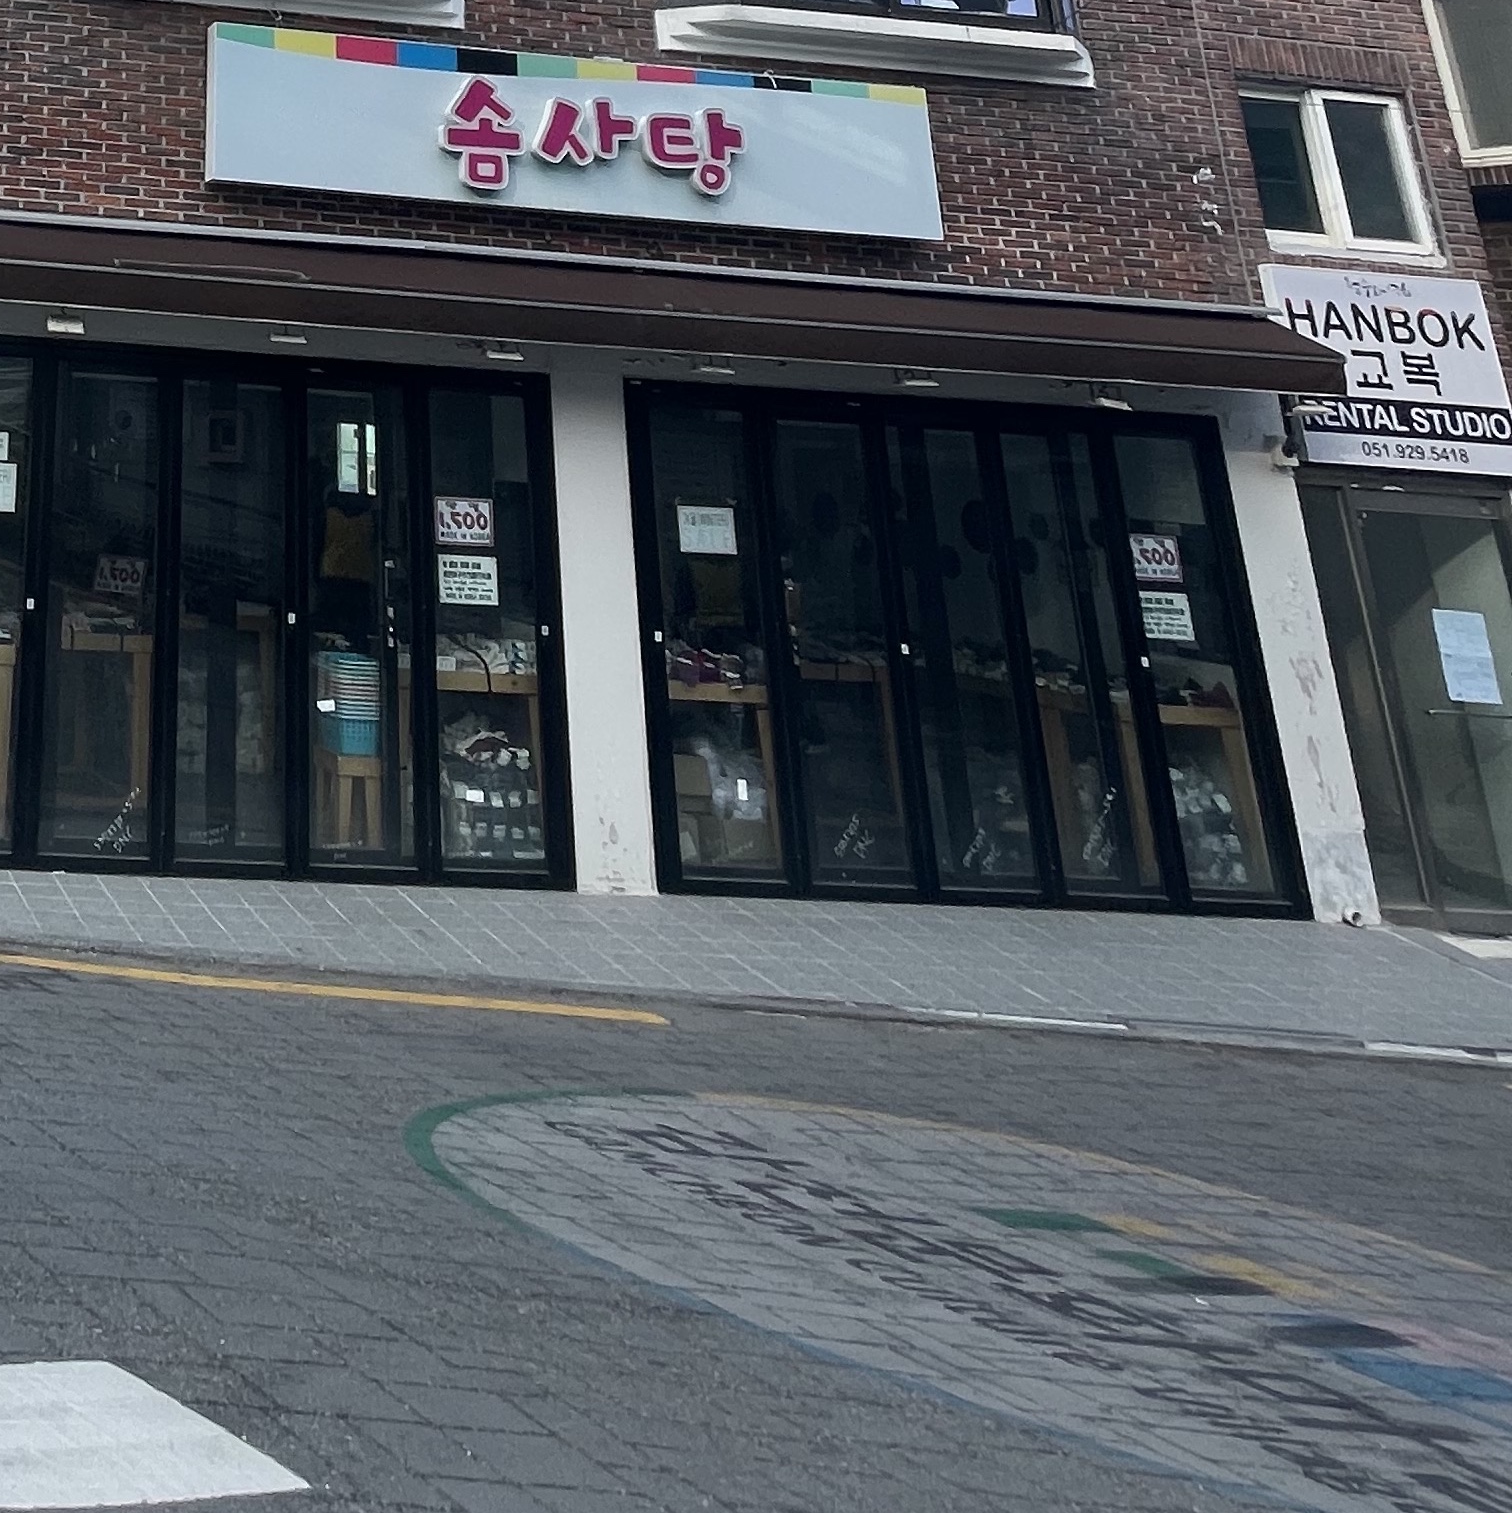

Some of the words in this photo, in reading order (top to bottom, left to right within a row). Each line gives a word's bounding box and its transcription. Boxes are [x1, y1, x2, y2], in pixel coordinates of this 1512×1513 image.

[441, 76, 744, 194] 솜사탕
[1284, 297, 1486, 352] HANBOK
[1349, 349, 1444, 397] 교복
[1411, 406, 1512, 440] STUDIO
[1361, 440, 1471, 465] 051.929.5418
